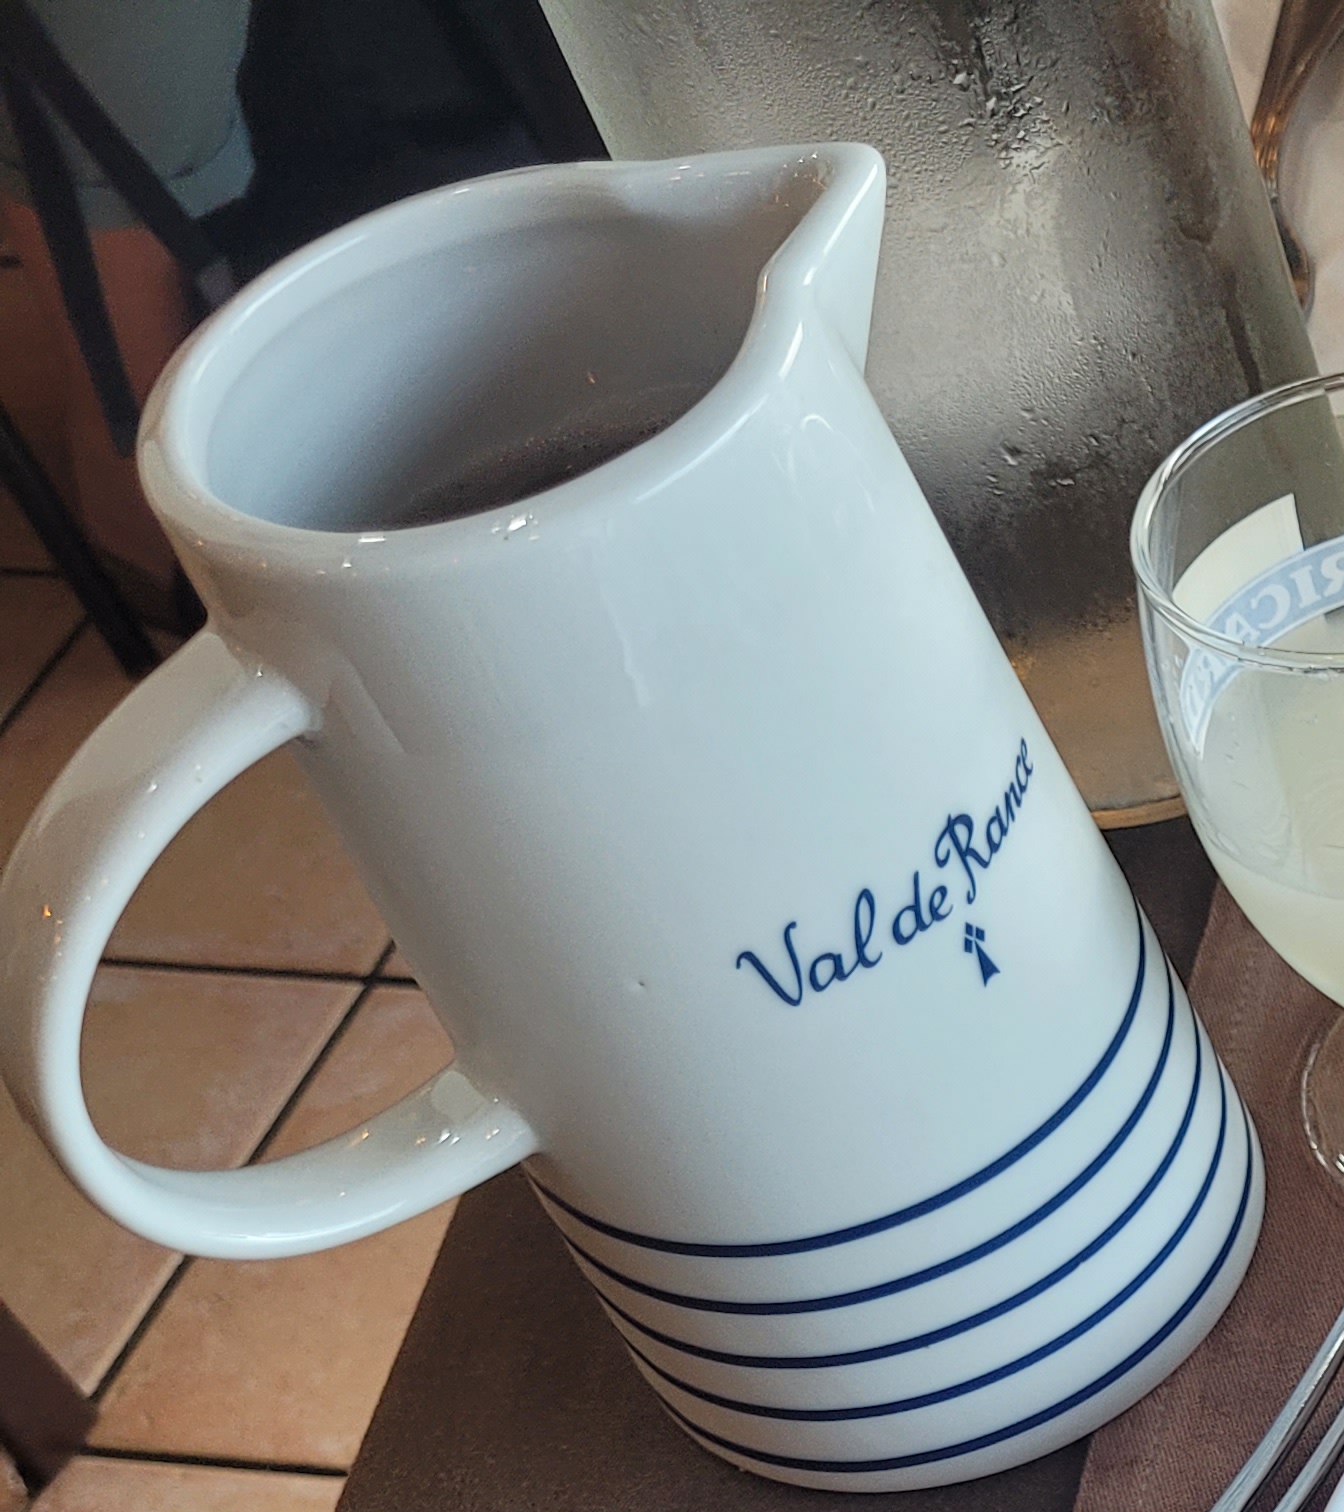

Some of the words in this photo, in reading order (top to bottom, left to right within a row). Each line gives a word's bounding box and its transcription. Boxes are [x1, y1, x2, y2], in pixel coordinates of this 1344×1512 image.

[735, 887, 883, 1007] Val
[892, 869, 954, 946] de
[934, 736, 1034, 905] Rance
